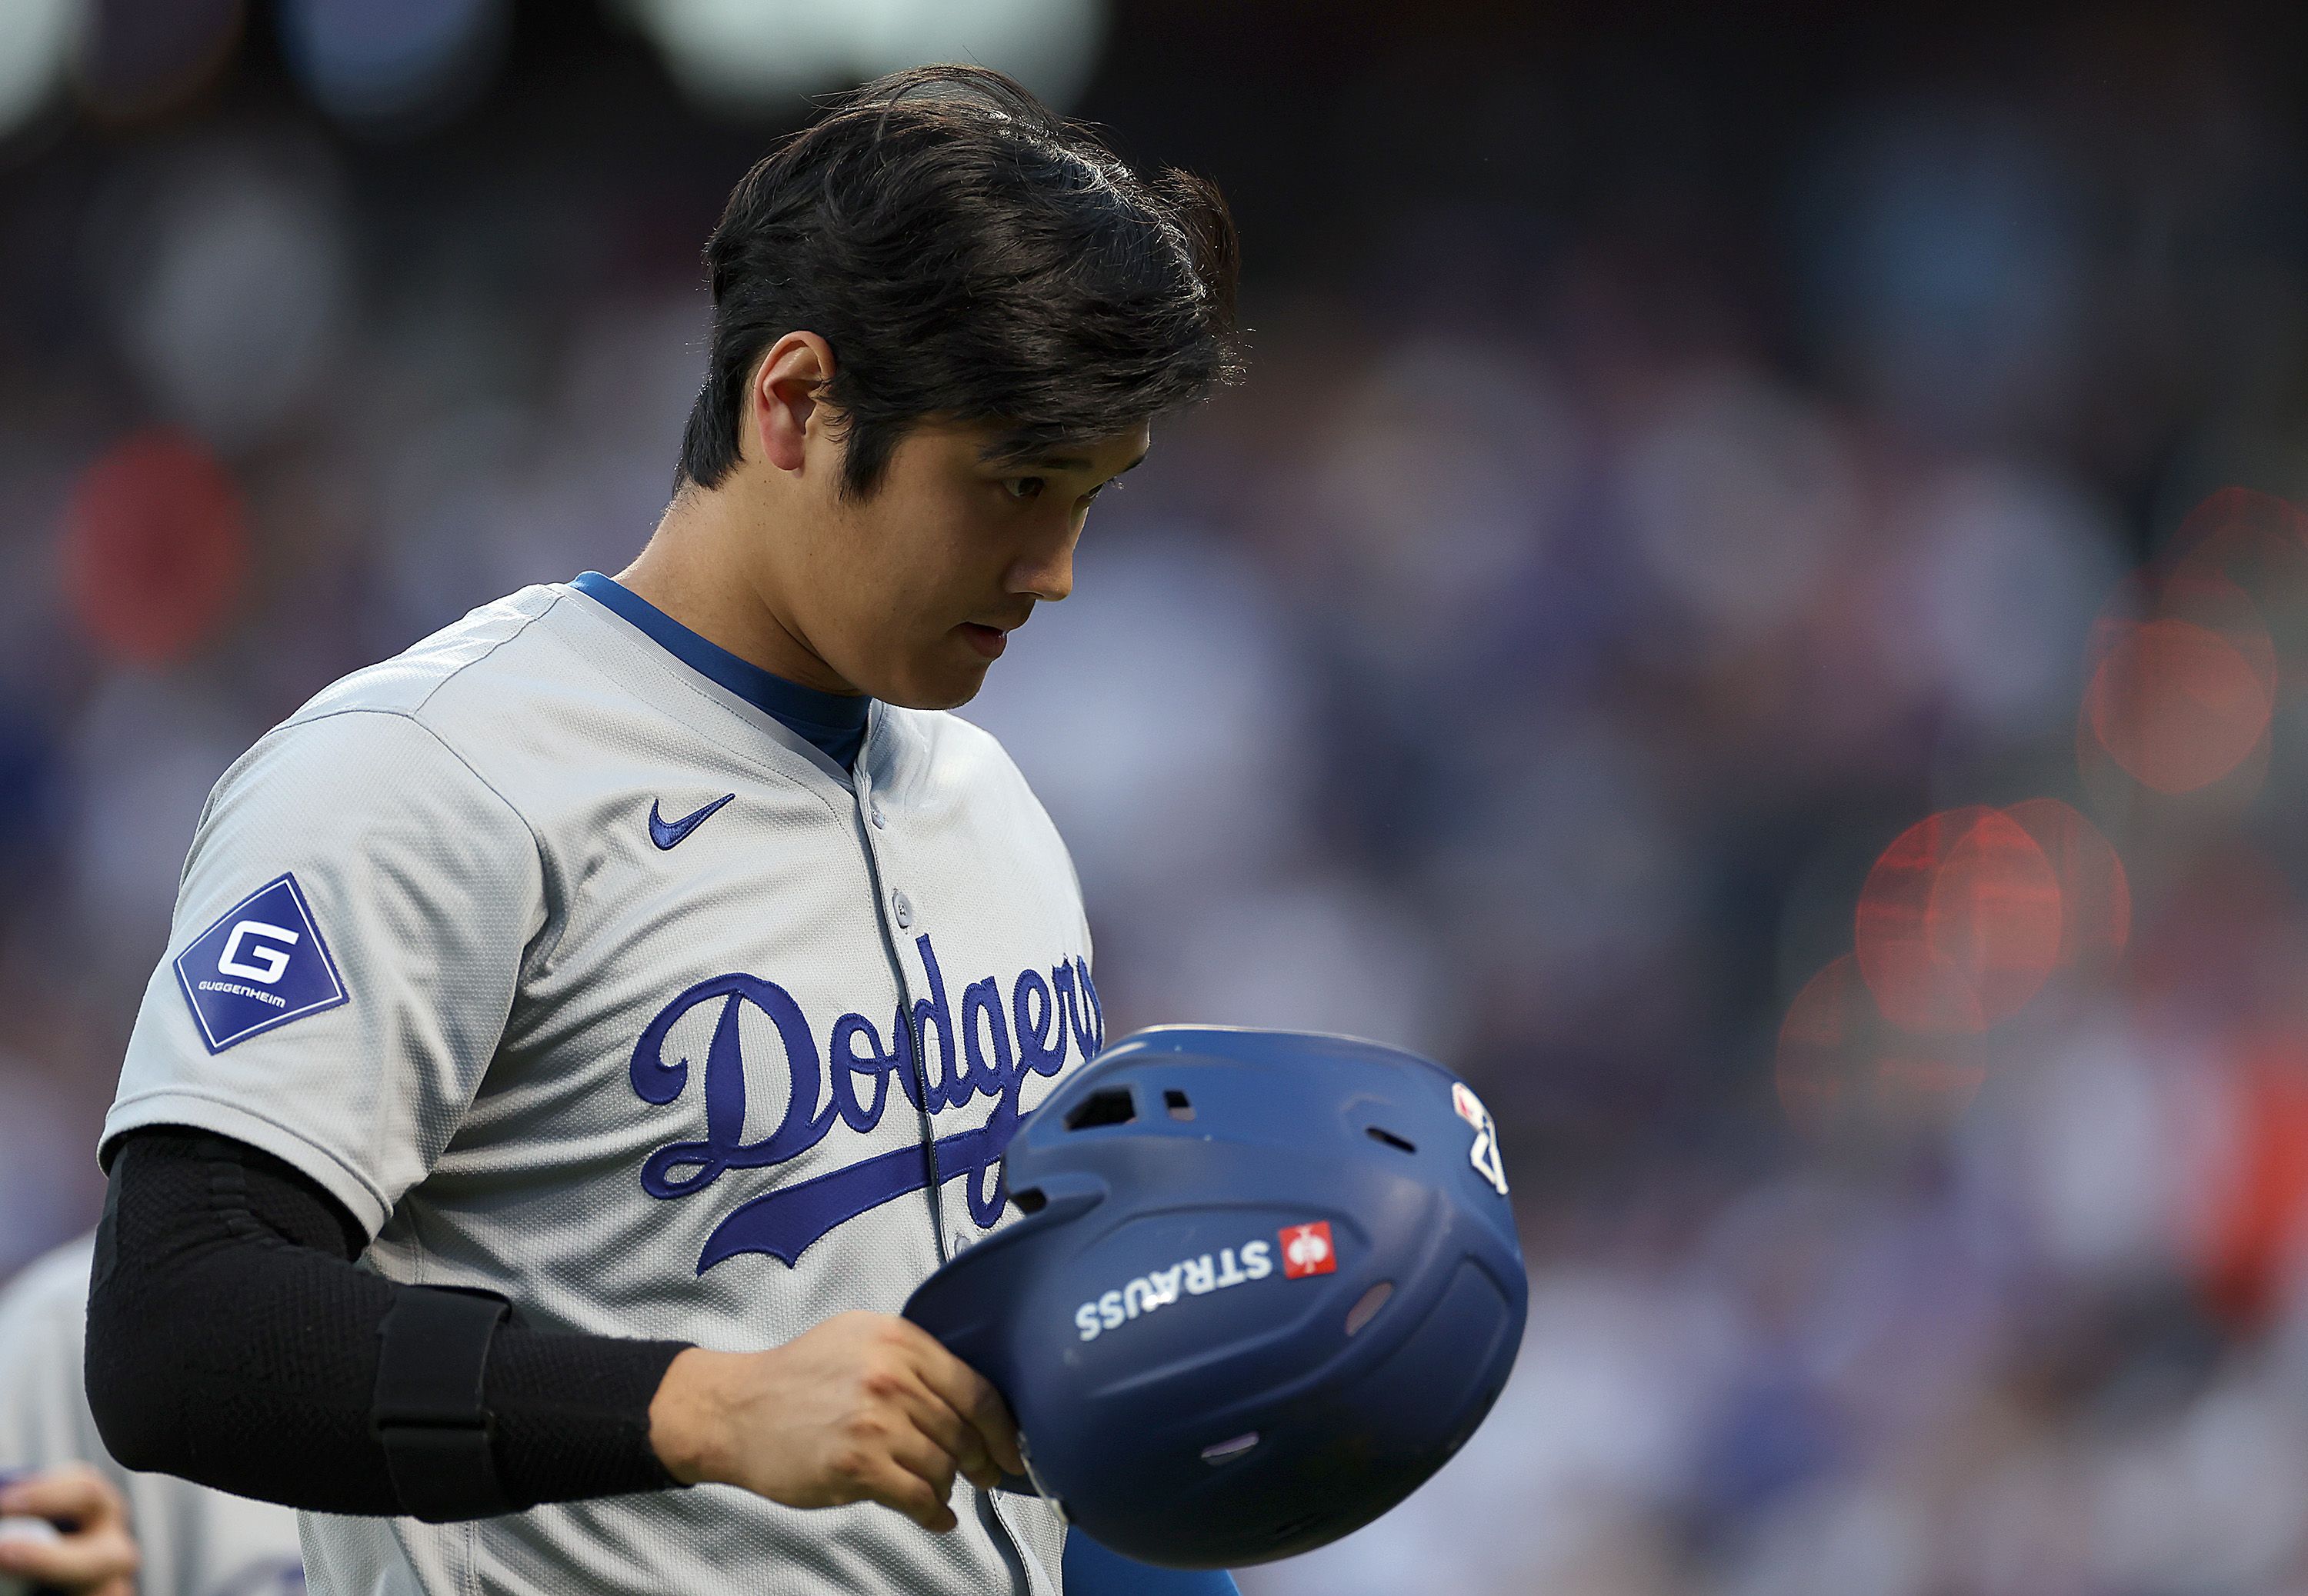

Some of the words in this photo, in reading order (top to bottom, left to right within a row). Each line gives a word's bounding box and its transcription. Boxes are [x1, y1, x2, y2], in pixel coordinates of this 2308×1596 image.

[218, 920, 299, 985] G
[198, 981, 286, 1008] GUGGENHEIM
[1075, 1239, 1272, 1341] STRAUSS
